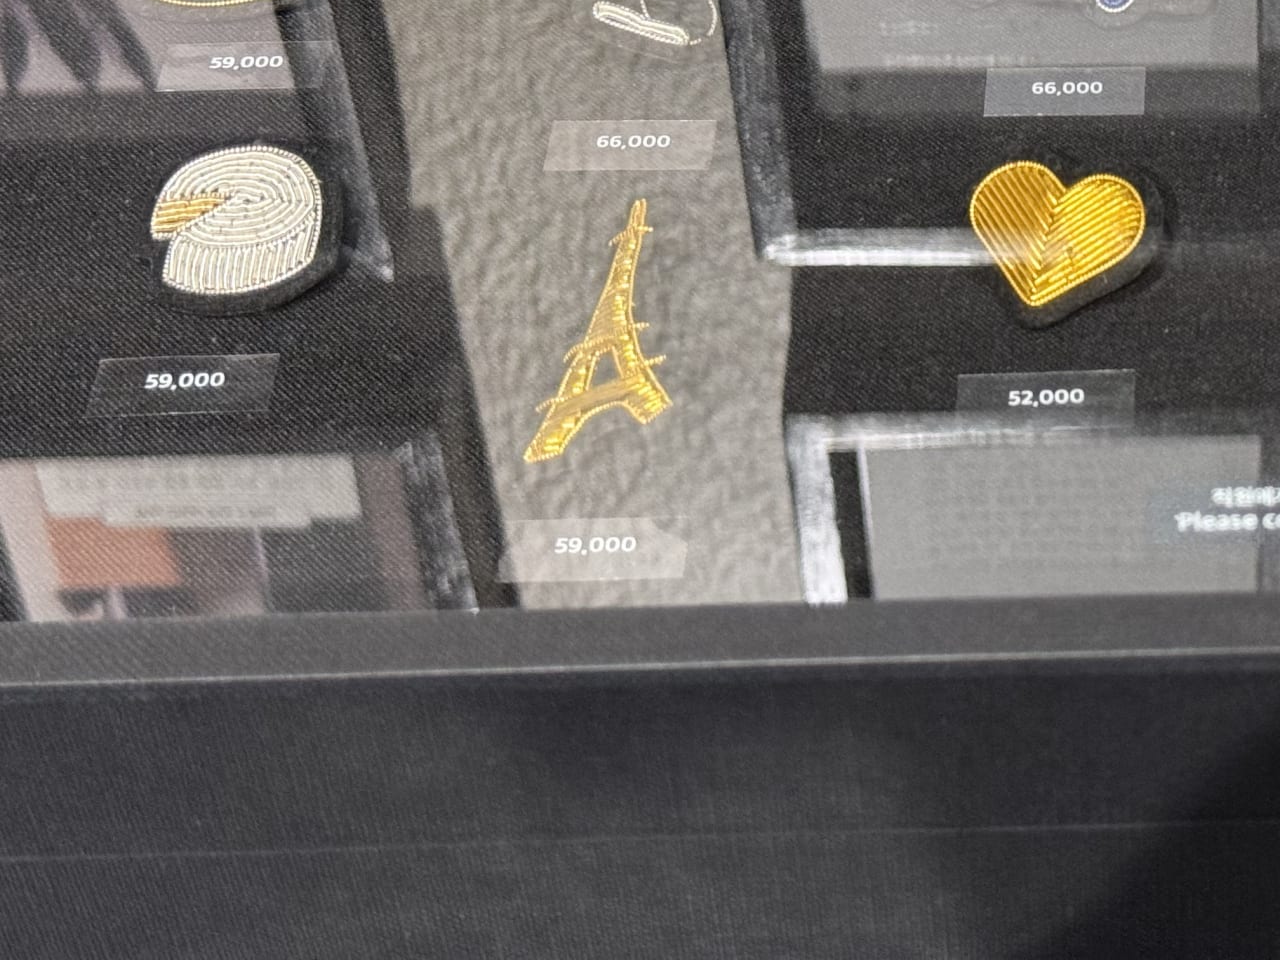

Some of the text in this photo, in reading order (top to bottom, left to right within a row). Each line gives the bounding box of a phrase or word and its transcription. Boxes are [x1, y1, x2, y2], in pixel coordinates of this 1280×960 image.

[208, 55, 284, 71] 59,000
[1031, 81, 1103, 97] 66,000
[596, 134, 671, 150] 66,000
[144, 371, 226, 392] 59,000
[1008, 388, 1085, 408] 52,000
[1175, 510, 1259, 532] Please
[554, 536, 637, 556] 59,000
